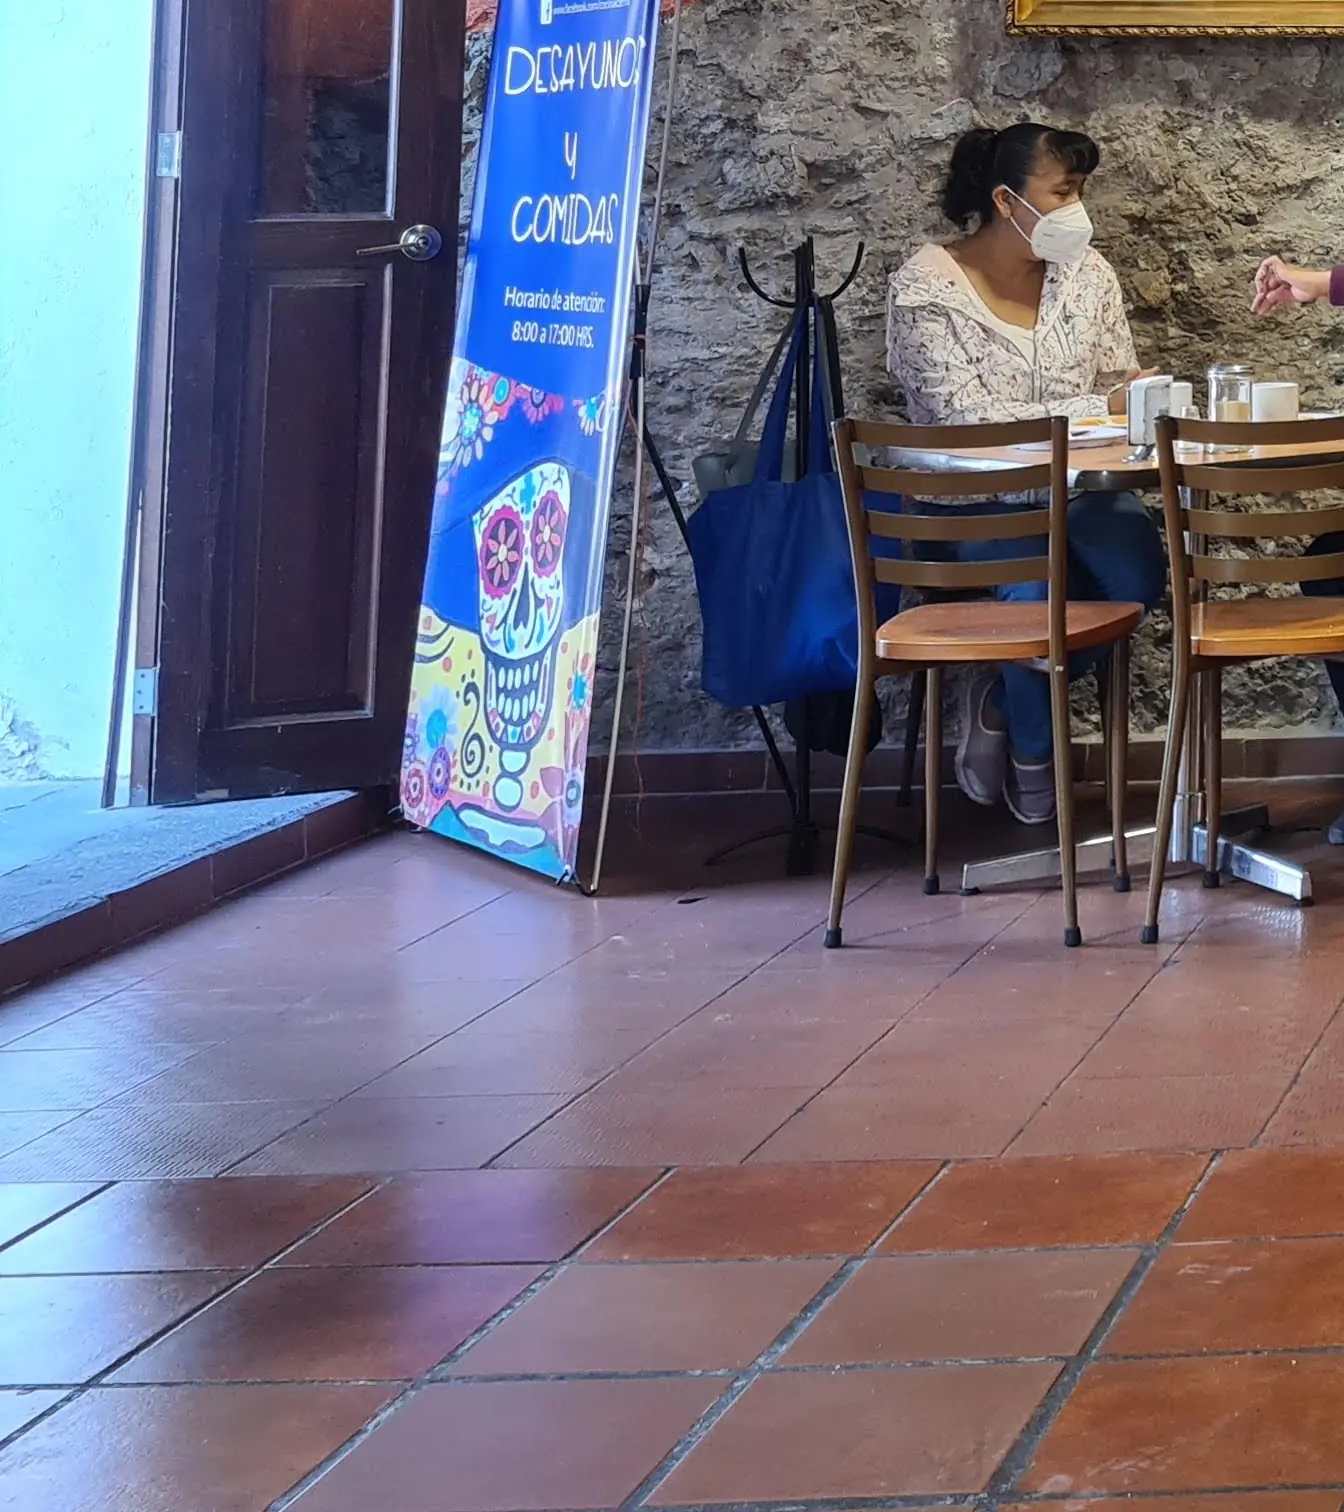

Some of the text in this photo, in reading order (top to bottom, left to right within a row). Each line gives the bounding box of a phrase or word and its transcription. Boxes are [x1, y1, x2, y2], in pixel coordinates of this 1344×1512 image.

[504, 35, 646, 95] DESAYUNOS
[511, 193, 618, 245] COMIDAS
[504, 285, 550, 309] Horario
[551, 288, 562, 310] de
[511, 320, 595, 348] 8:00 a 17:00 HRS.
